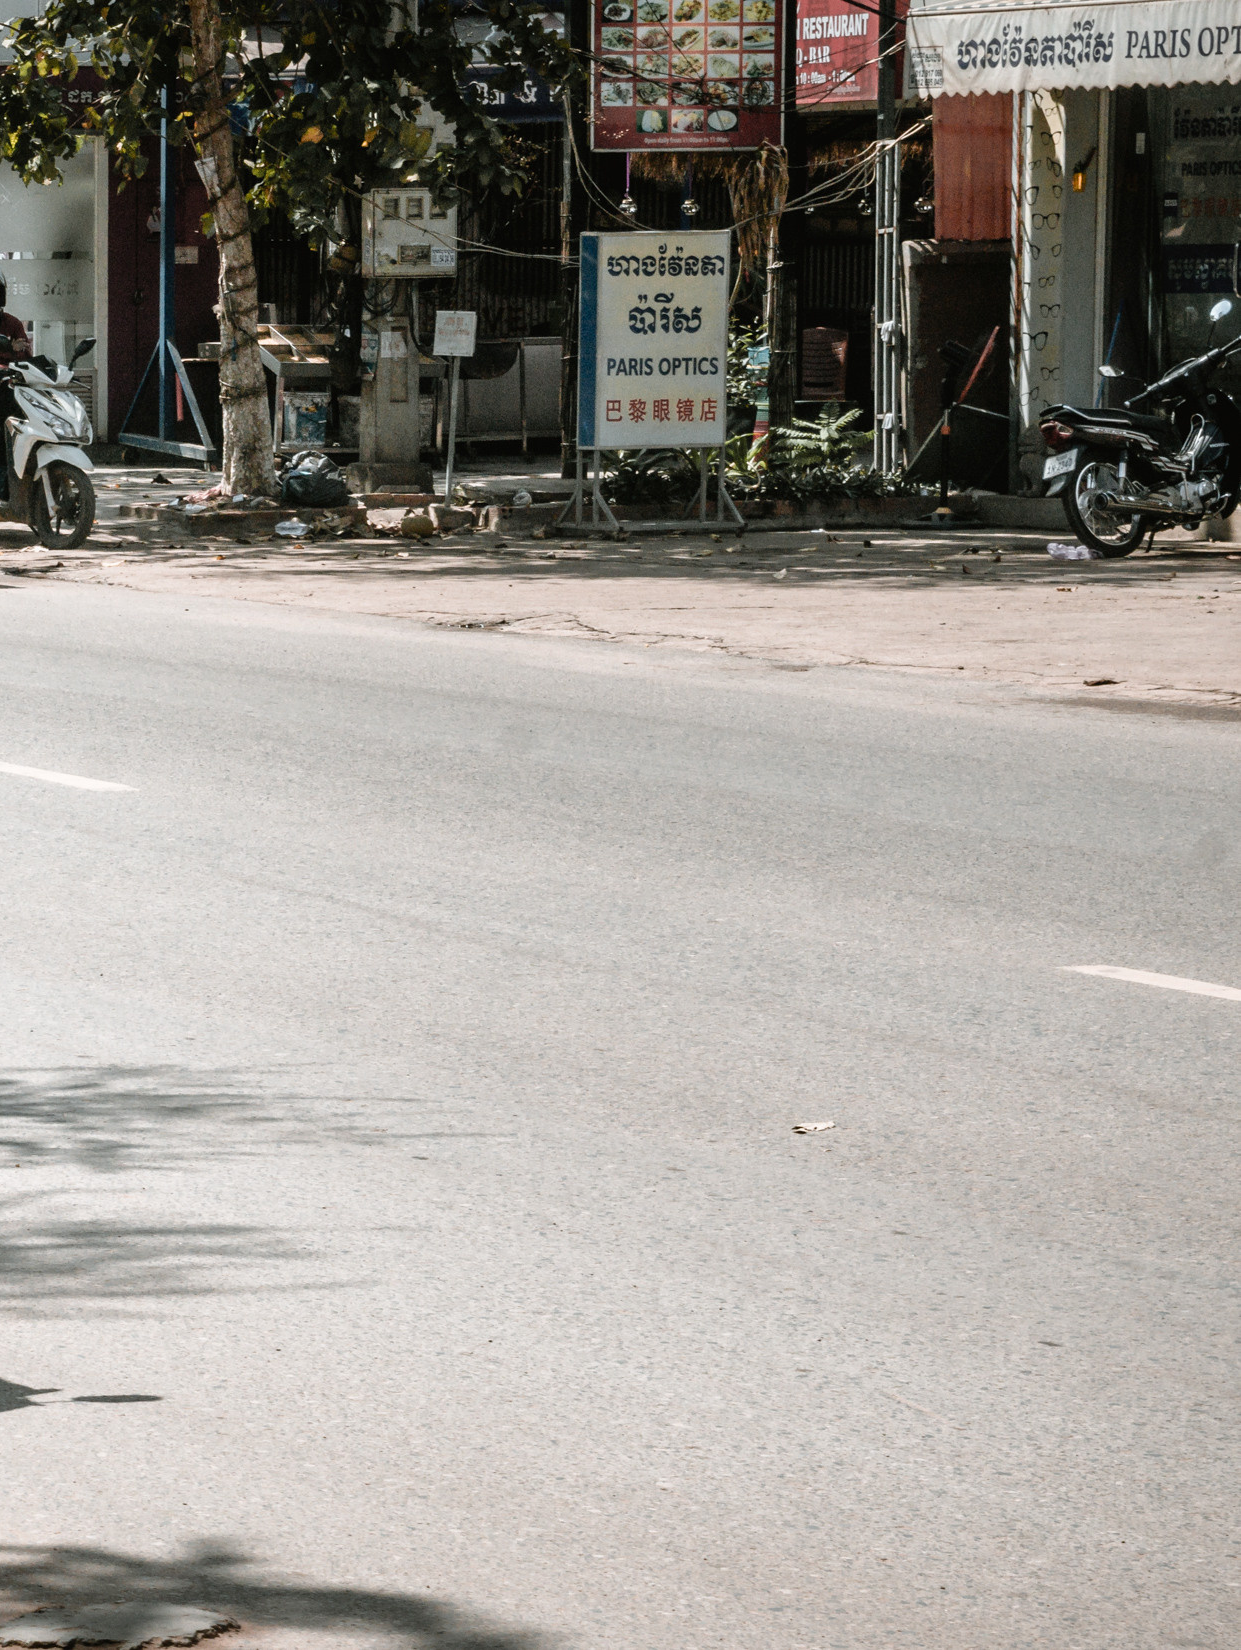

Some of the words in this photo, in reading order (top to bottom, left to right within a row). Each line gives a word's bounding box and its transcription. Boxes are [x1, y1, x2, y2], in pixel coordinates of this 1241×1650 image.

[802, 13, 869, 40] RESTAURANT
[1125, 28, 1191, 58] PARIS
[808, 46, 831, 64] BAR
[1181, 161, 1207, 176] PARIS
[606, 357, 654, 376] PARIS
[657, 356, 719, 376] OPTICS
[606, 397, 718, 423] 巴黎眼镜店
